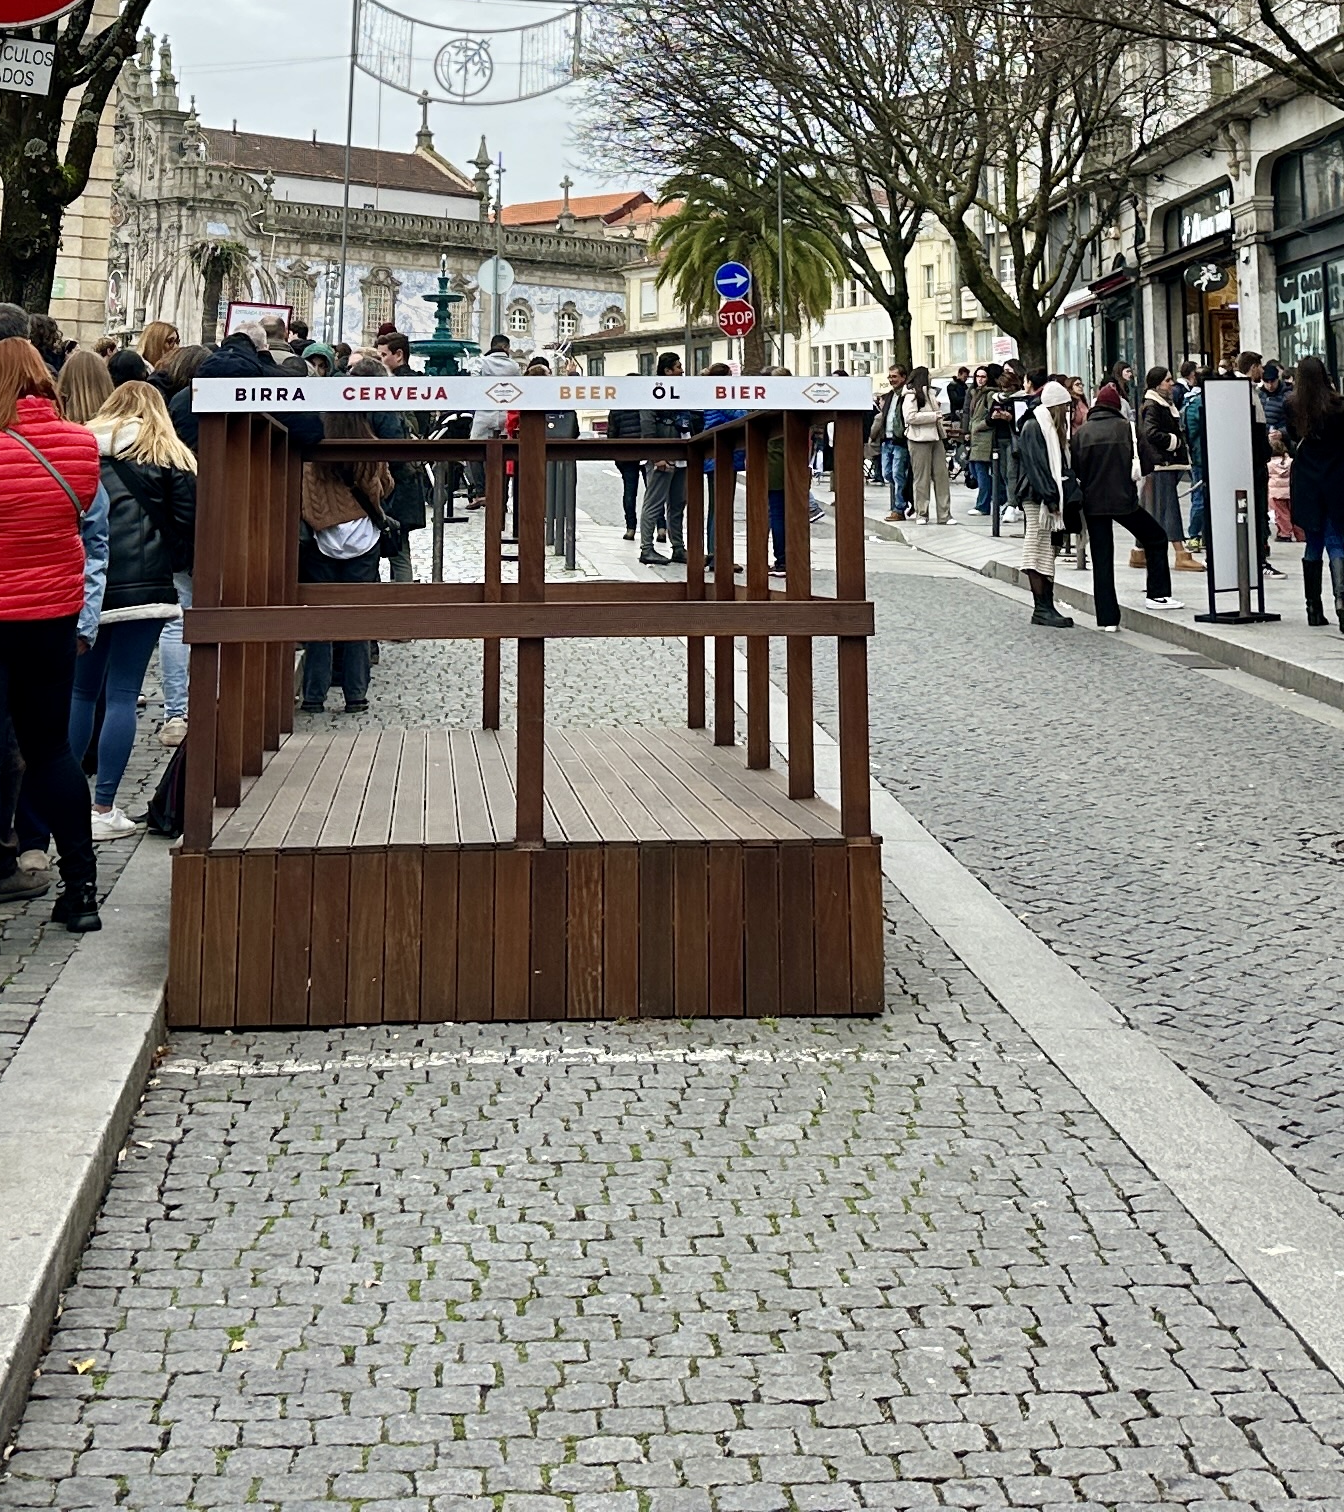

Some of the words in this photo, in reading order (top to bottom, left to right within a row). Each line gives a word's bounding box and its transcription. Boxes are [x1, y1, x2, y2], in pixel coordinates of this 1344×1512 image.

[720, 311, 752, 326] STOP
[235, 387, 306, 402] BIRRA
[342, 386, 449, 401] CERVEJA
[559, 385, 617, 400] BEER
[652, 381, 680, 400] ÖL
[715, 385, 766, 400] BIER
